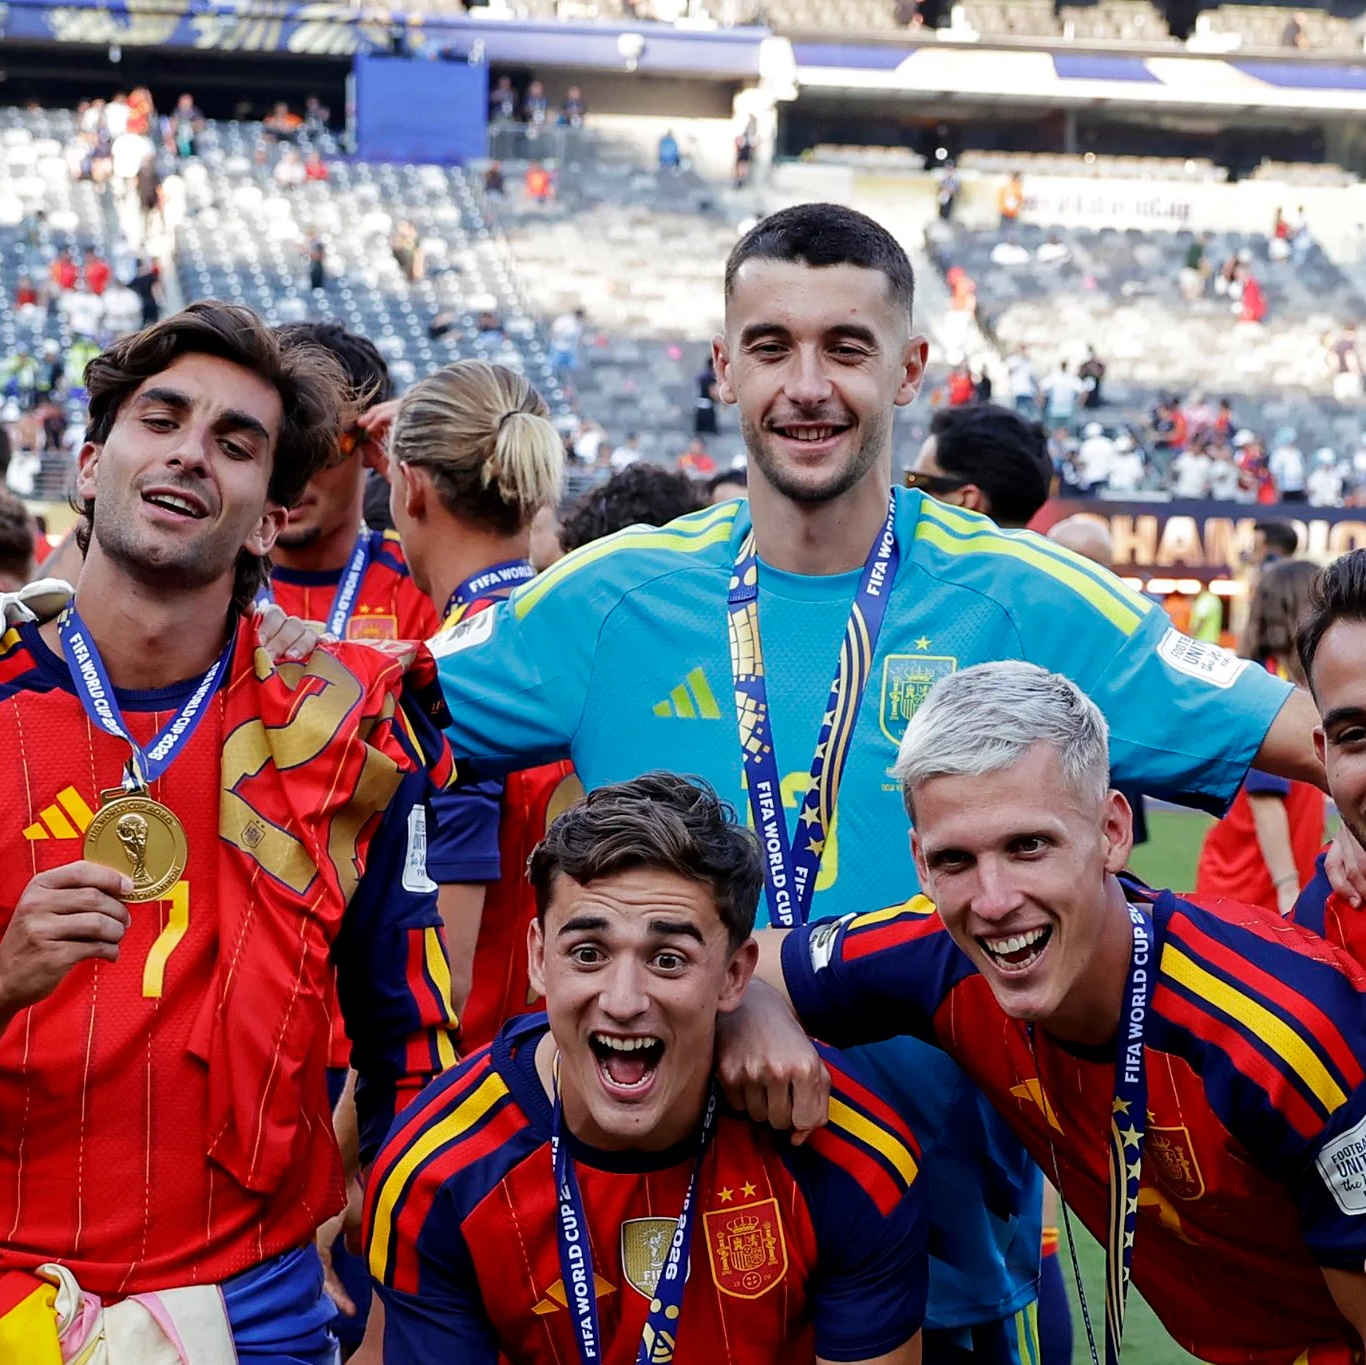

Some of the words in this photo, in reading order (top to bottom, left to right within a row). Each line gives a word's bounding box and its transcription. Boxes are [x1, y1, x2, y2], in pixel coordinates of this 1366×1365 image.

[469, 572, 502, 593] FIFA
[866, 562, 888, 597] FIFA
[69, 632, 89, 664] FIFA
[79, 660, 105, 698] WORLD
[94, 696, 113, 719] CUP
[182, 680, 212, 719] WORLD
[170, 714, 191, 738] CUP
[148, 733, 179, 761] 2026
[127, 800, 147, 810] CUP
[757, 781, 776, 822] FIFA
[762, 825, 787, 889] WORLD
[794, 866, 810, 903] FIF
[775, 889, 794, 927] CUP
[142, 878, 189, 998] 7
[1133, 926, 1150, 966] CUP
[1128, 968, 1148, 1040] WORLD
[1125, 1042, 1143, 1084] FIFA
[1340, 1177, 1363, 1193] the
[561, 1203, 580, 1242] CUP
[665, 1213, 688, 1281] 2026
[567, 1244, 591, 1316] WORLD
[580, 1316, 597, 1359] FIFA
